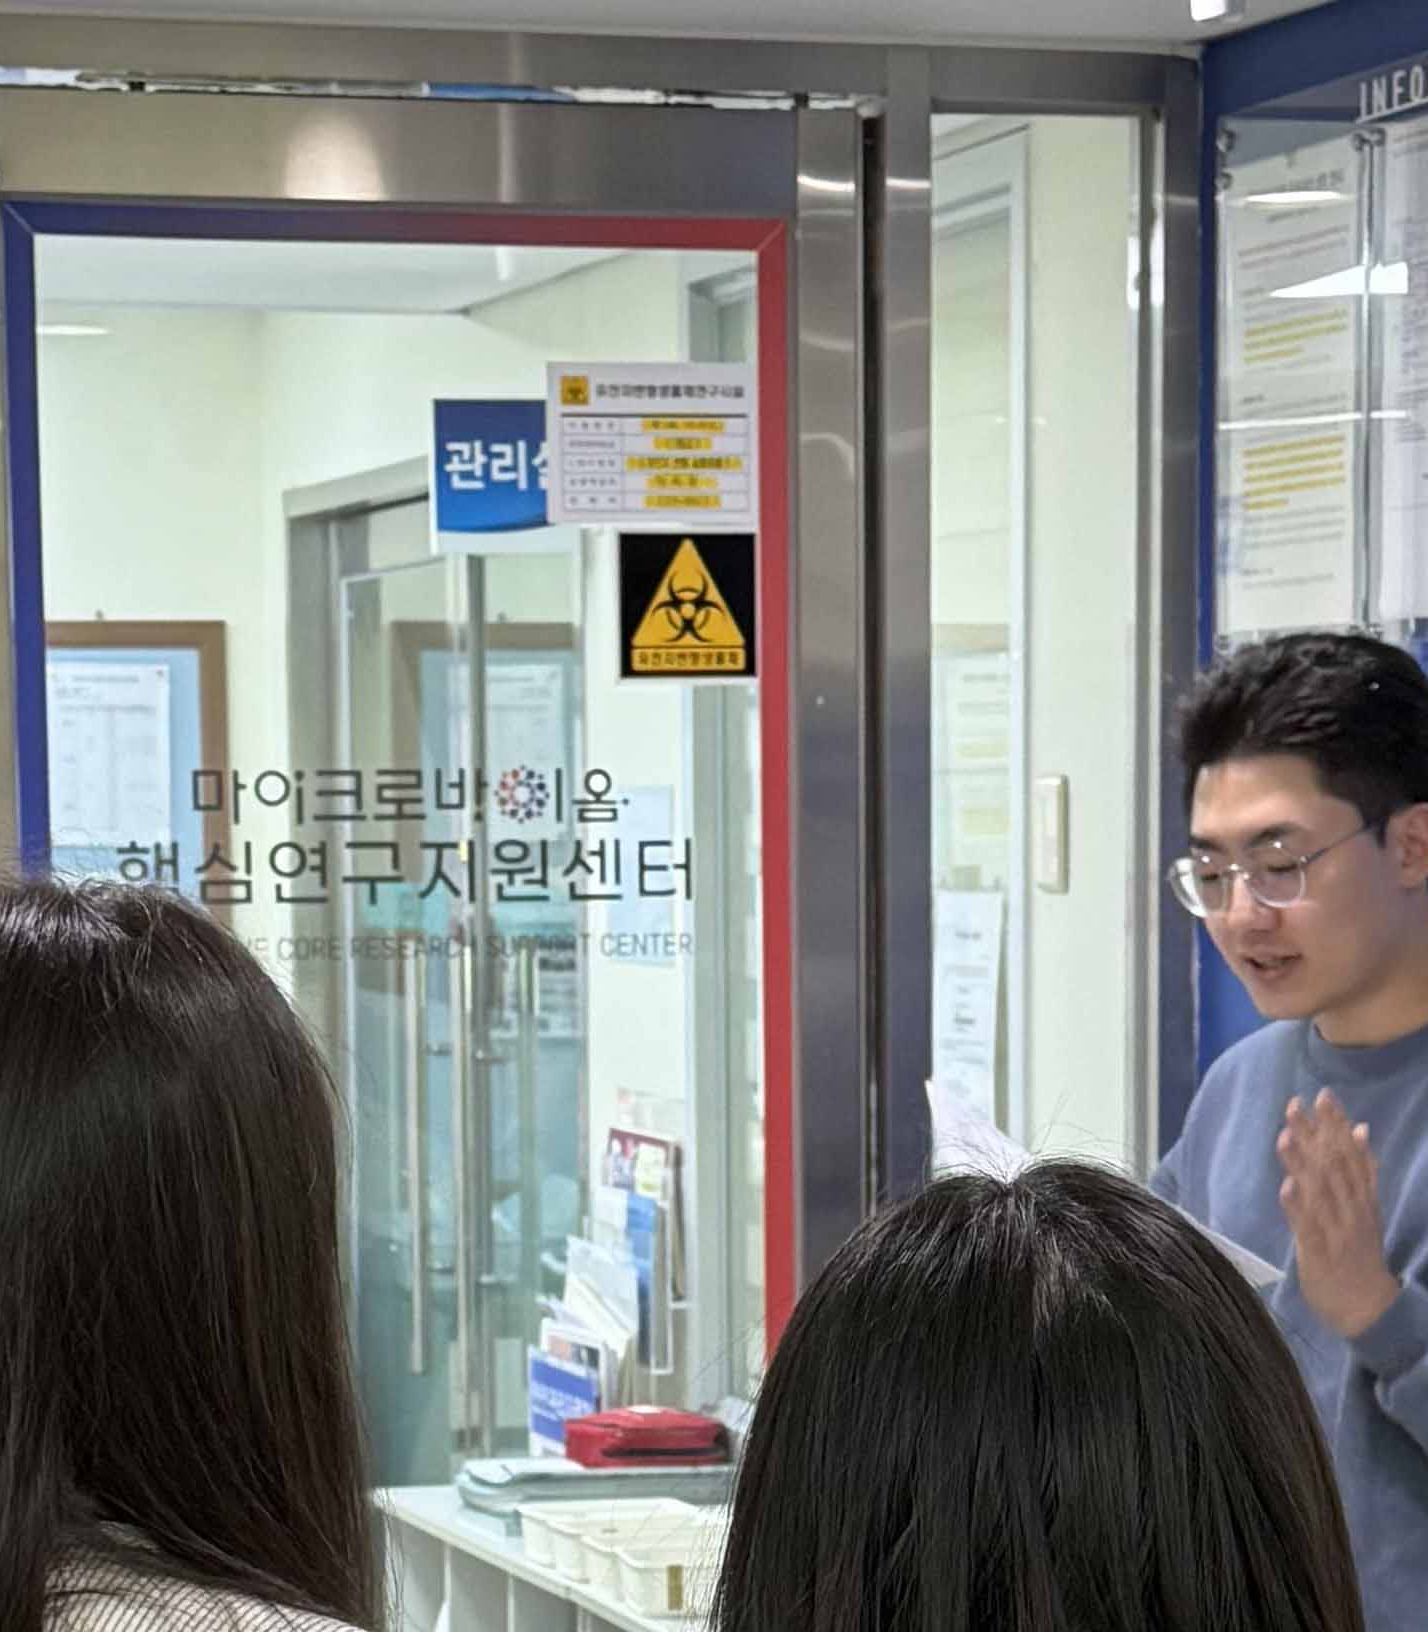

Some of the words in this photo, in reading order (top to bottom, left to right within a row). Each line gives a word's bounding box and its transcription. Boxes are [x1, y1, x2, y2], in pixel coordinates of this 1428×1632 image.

[191, 766, 629, 825] 마이크로바이옴
[116, 838, 693, 904] 핵심연구지원센터
[599, 931, 694, 957] CENTER
